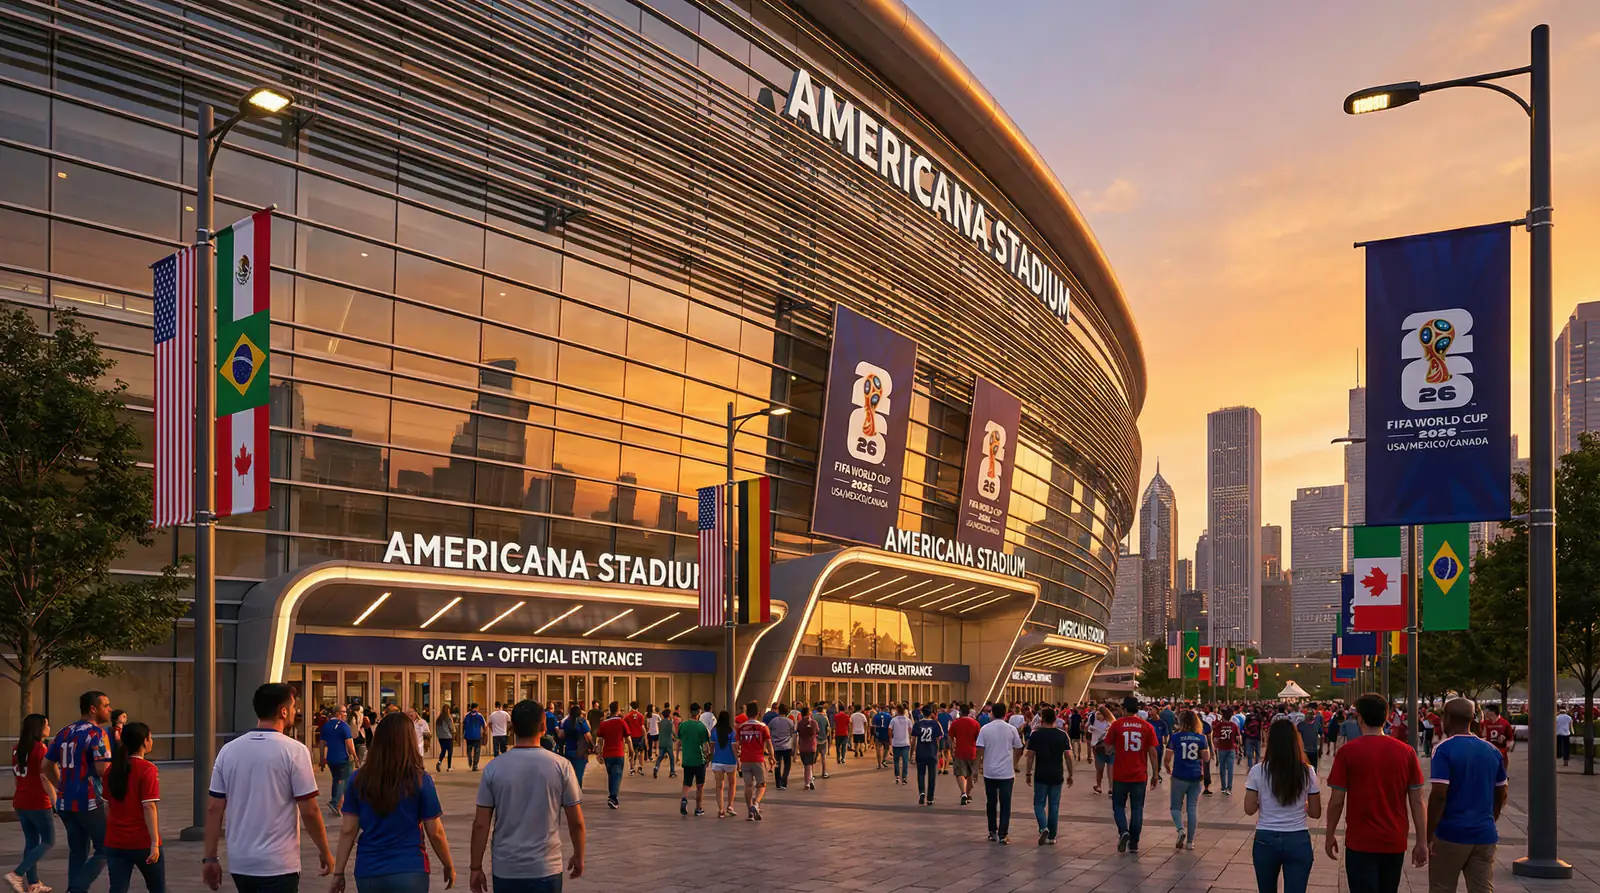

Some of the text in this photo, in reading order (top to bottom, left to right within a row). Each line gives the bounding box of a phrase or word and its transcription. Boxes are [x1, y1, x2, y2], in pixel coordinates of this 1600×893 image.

[786, 68, 1070, 324] AMERICANA STADIUM
[1419, 386, 1457, 403] 26
[1387, 413, 1488, 430] FIFA WORLD CUP
[1418, 428, 1457, 439] 2026
[856, 436, 877, 457] 26
[1387, 437, 1489, 452] USA/MEXICO/CANADA
[834, 461, 891, 485] FIFA WORLD CUP
[851, 480, 873, 493] 2026
[982, 479, 996, 494] 26
[383, 531, 590, 580] AMERICANA
[884, 526, 974, 567] AMERICANA
[977, 547, 1026, 577] STADIUM
[422, 644, 467, 661] GATE
[470, 645, 484, 662] A
[498, 647, 568, 664] OFFICIAL
[571, 650, 643, 666] ENTRANCE
[831, 661, 852, 674] GATE
[853, 663, 860, 674] A
[864, 663, 898, 675] OFFICIAL
[898, 665, 933, 677] ENTRANCE
[920, 727, 933, 742] 22
[1122, 731, 1142, 752] 15
[1220, 729, 1233, 740] 37
[60, 741, 76, 769] 11
[1180, 742, 1199, 760] 18
